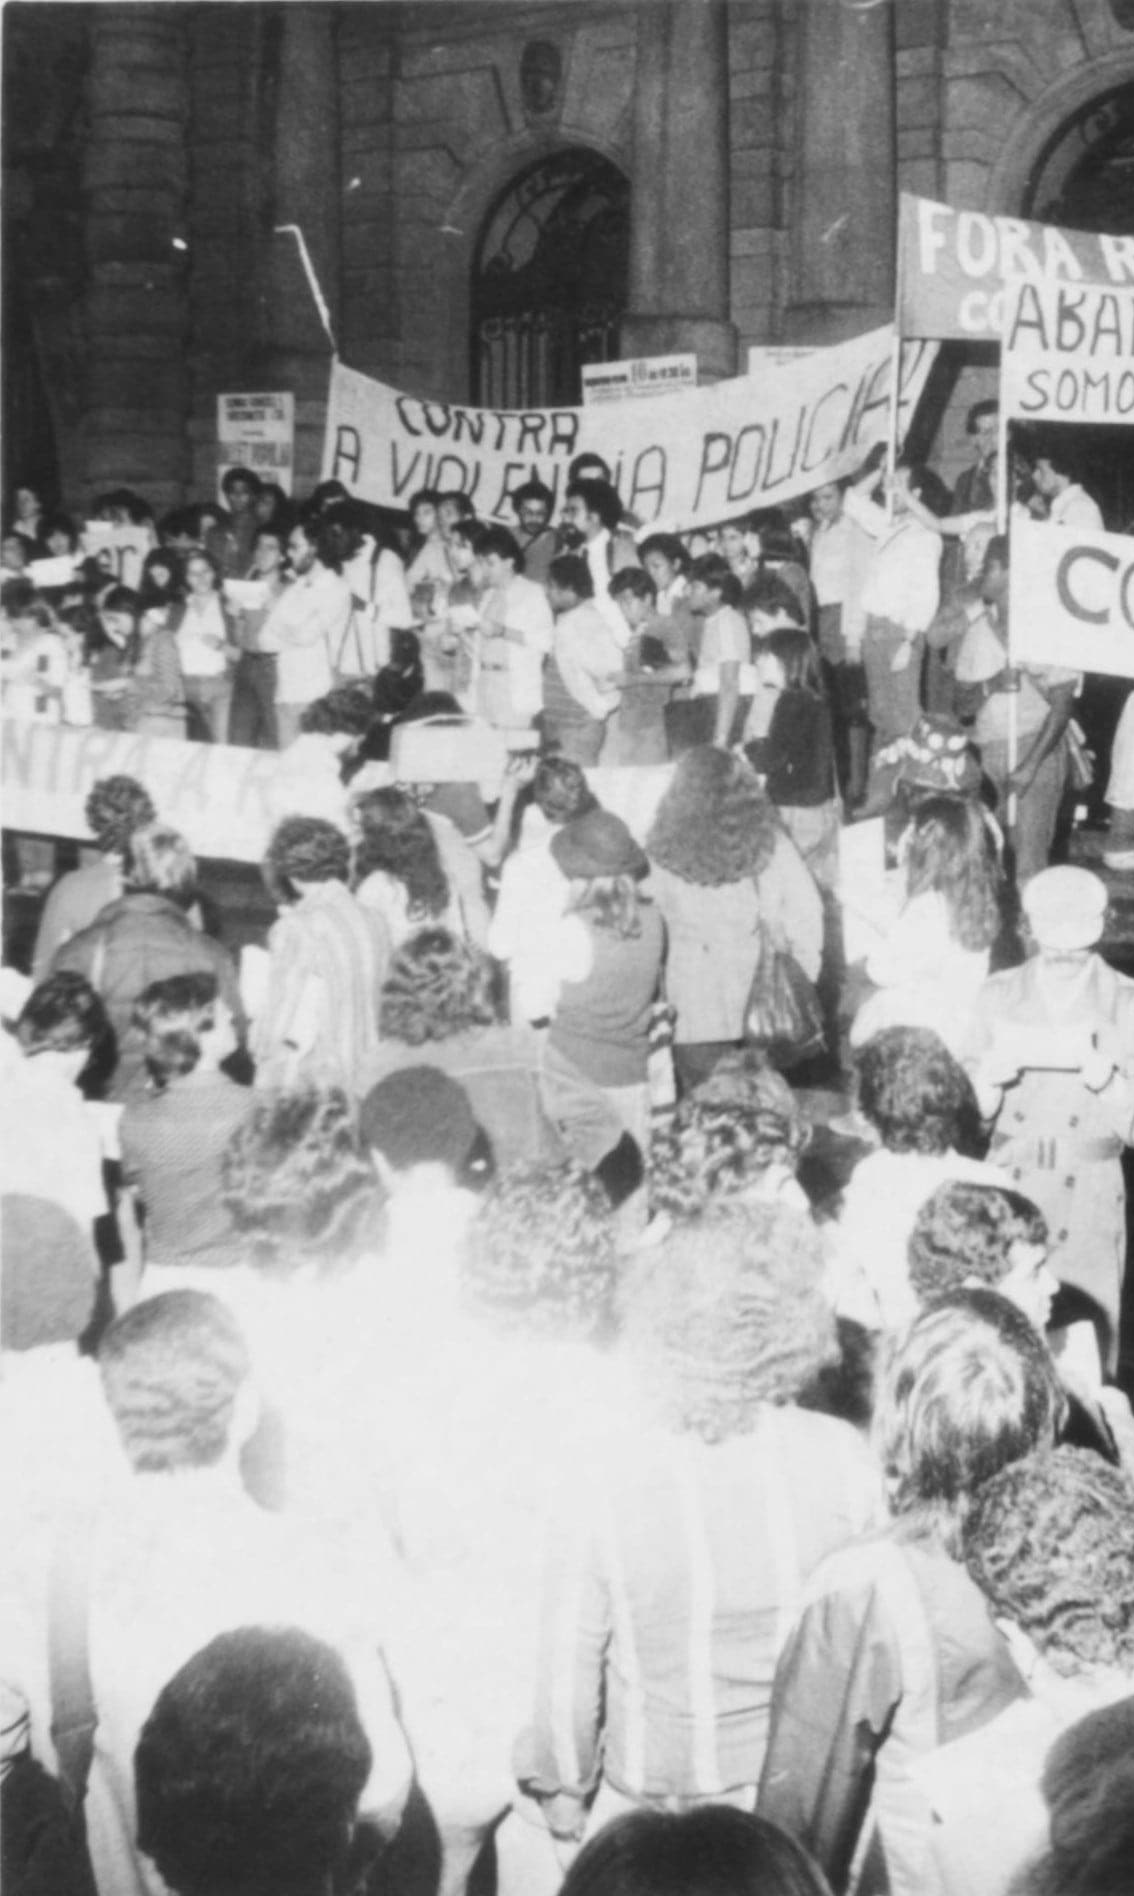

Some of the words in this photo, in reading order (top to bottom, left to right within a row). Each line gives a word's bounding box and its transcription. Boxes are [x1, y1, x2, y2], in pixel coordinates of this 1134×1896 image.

[917, 198, 1083, 282] FORA
[394, 395, 579, 456] CONTRA
[329, 425, 361, 484] A
[391, 440, 668, 521] VIOLENIA
